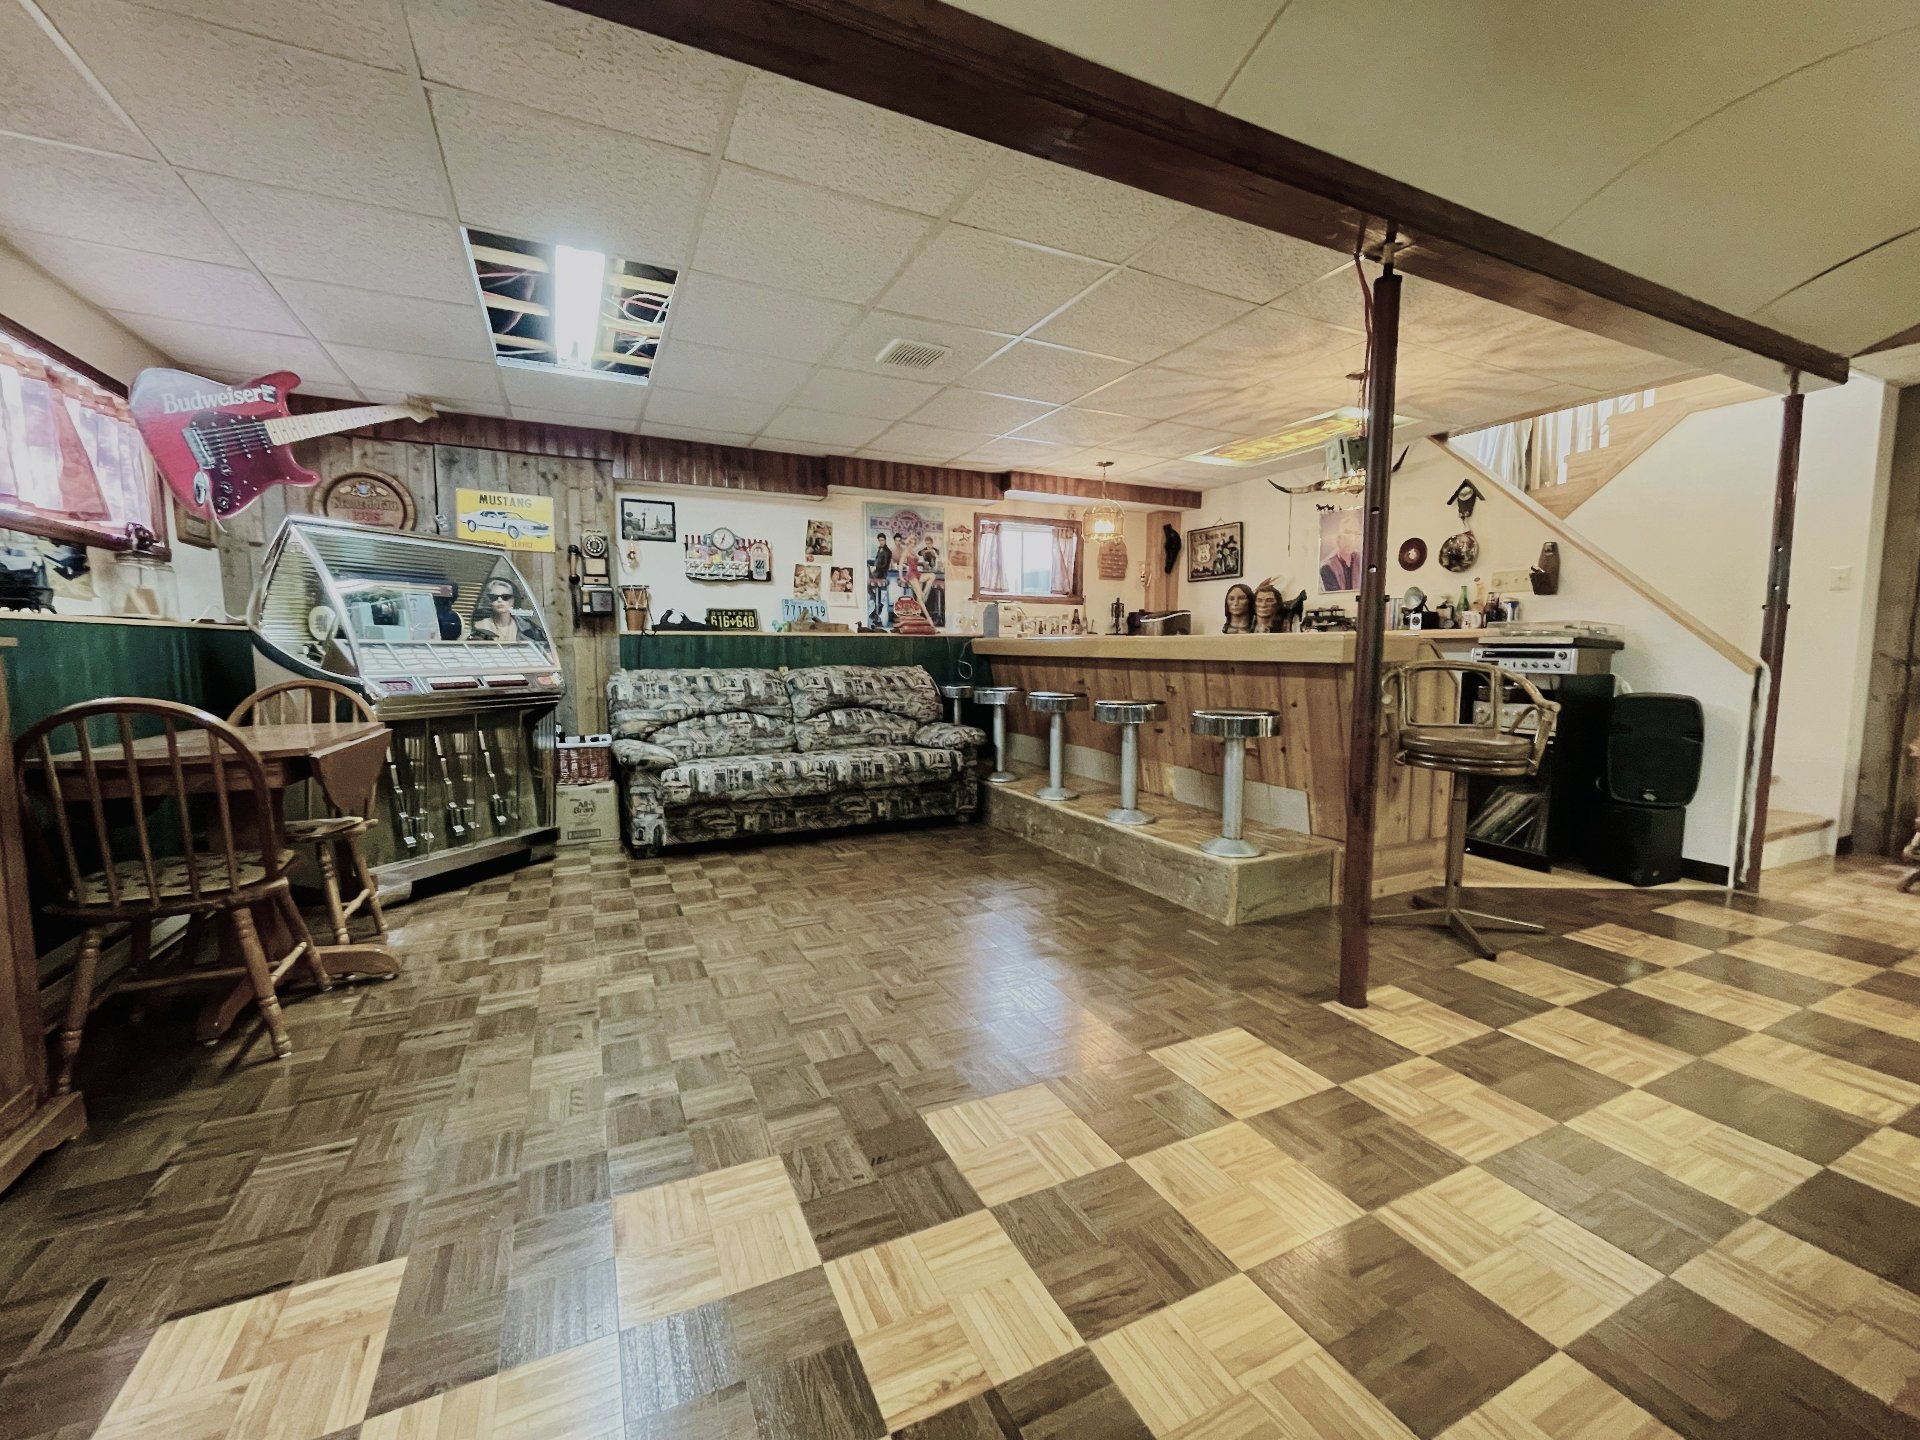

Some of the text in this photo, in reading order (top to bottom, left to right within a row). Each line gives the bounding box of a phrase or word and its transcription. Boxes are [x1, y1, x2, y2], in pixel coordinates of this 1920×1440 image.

[161, 386, 262, 414] Budweiser
[479, 494, 533, 509] MUSTANG
[809, 605, 826, 617] 119
